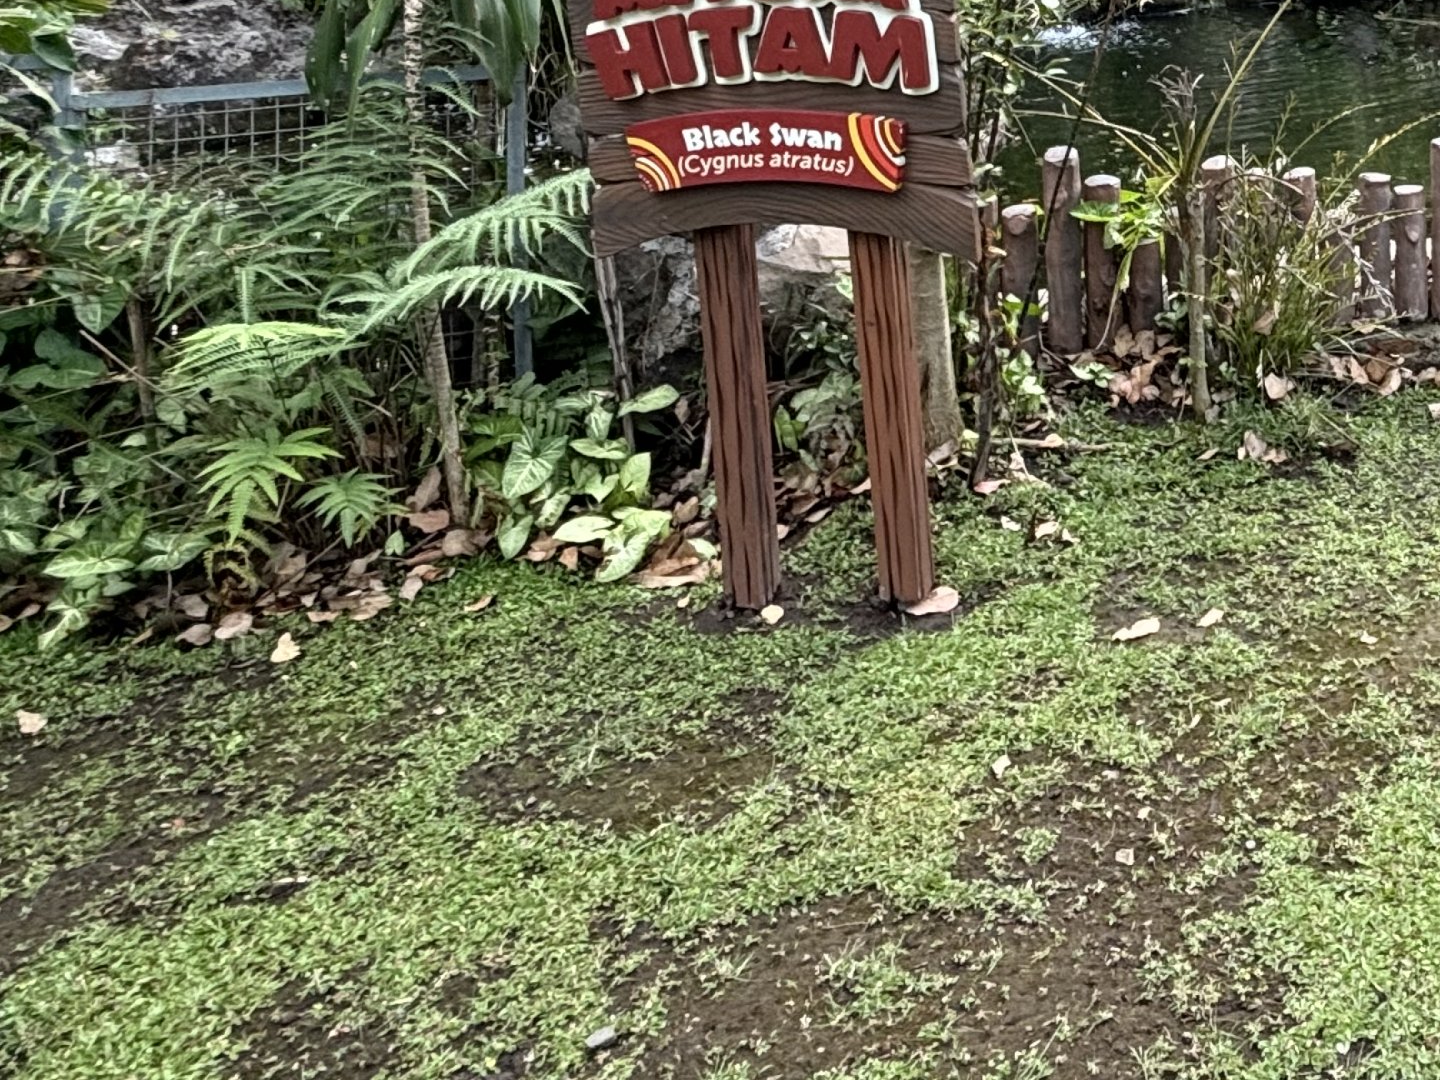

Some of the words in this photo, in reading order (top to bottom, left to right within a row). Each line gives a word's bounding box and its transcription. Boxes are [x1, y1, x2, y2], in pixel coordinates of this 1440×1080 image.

[586, 6, 936, 101] HITAM
[681, 121, 761, 152] Black
[768, 122, 843, 152] Swan
[677, 152, 765, 178] (Cygnus
[768, 151, 855, 177] atratus)
